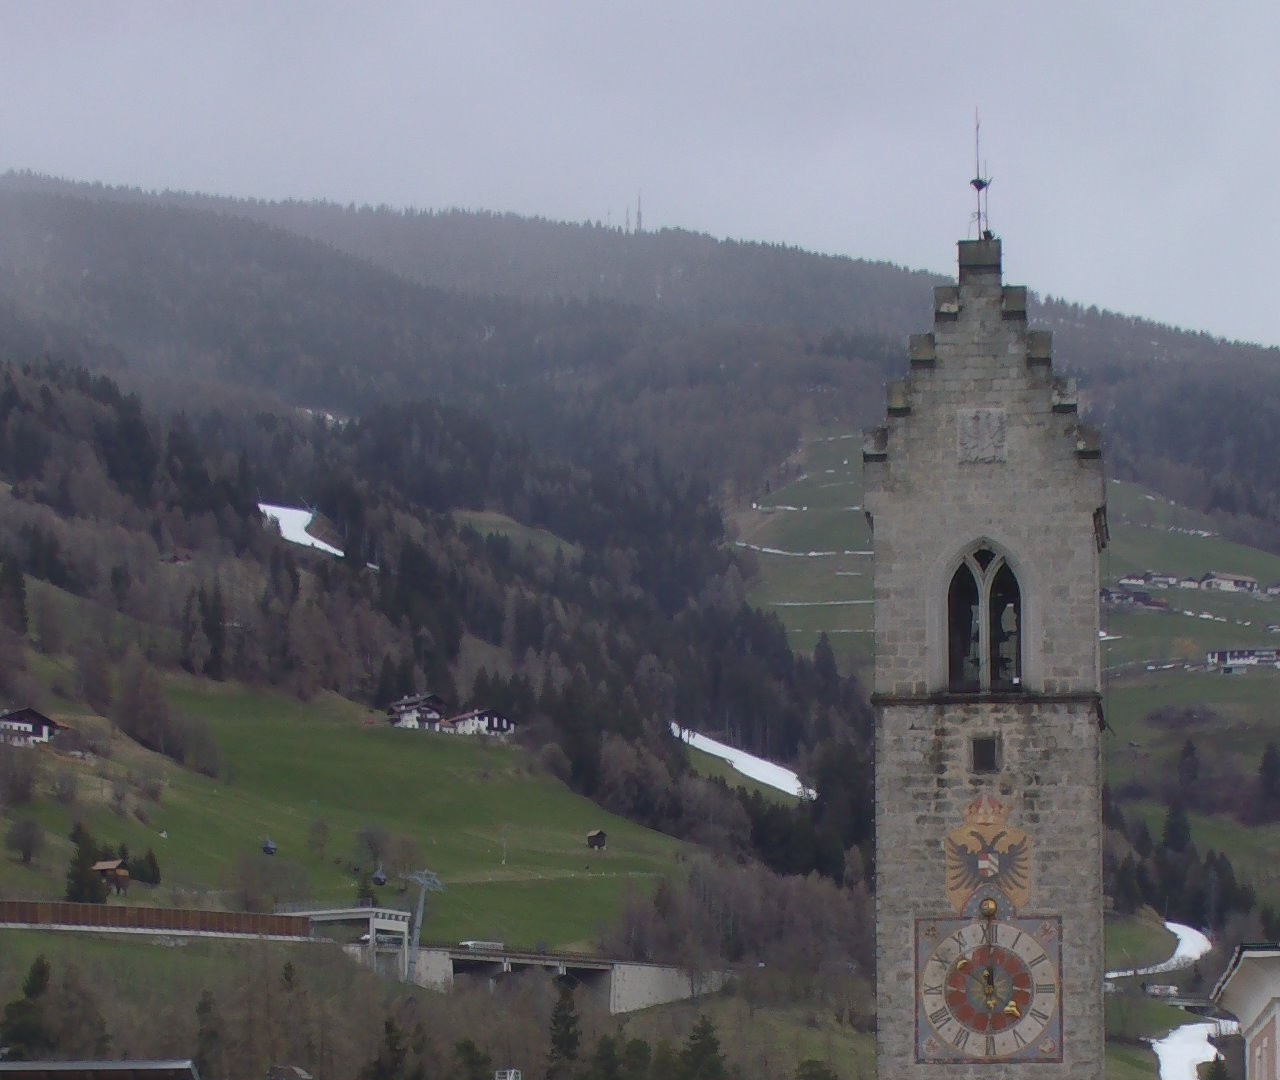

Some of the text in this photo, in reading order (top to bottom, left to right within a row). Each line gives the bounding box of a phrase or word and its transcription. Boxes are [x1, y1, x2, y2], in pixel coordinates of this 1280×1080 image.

[1028, 952, 1048, 969] II
[924, 983, 942, 995] IX
[1035, 983, 1056, 994] III
[1012, 1030, 1028, 1048] V
